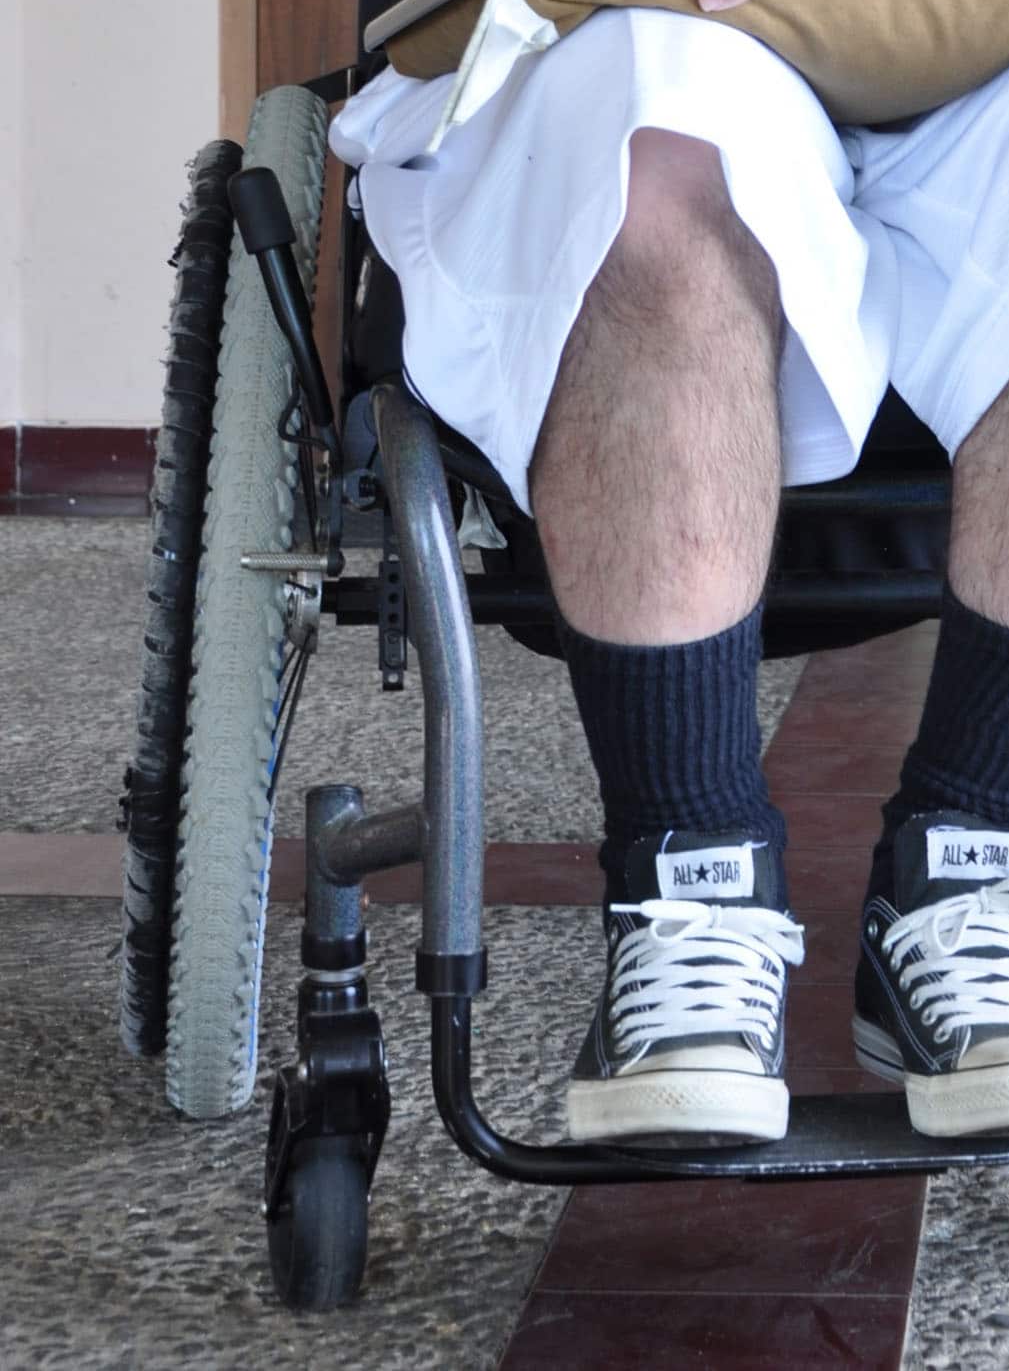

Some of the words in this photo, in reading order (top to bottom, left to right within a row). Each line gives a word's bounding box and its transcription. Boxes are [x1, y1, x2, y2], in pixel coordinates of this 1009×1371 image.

[941, 844, 963, 866] ALL
[982, 844, 1009, 867] STAR
[673, 864, 695, 886] ALL
[712, 861, 740, 884] STAR
